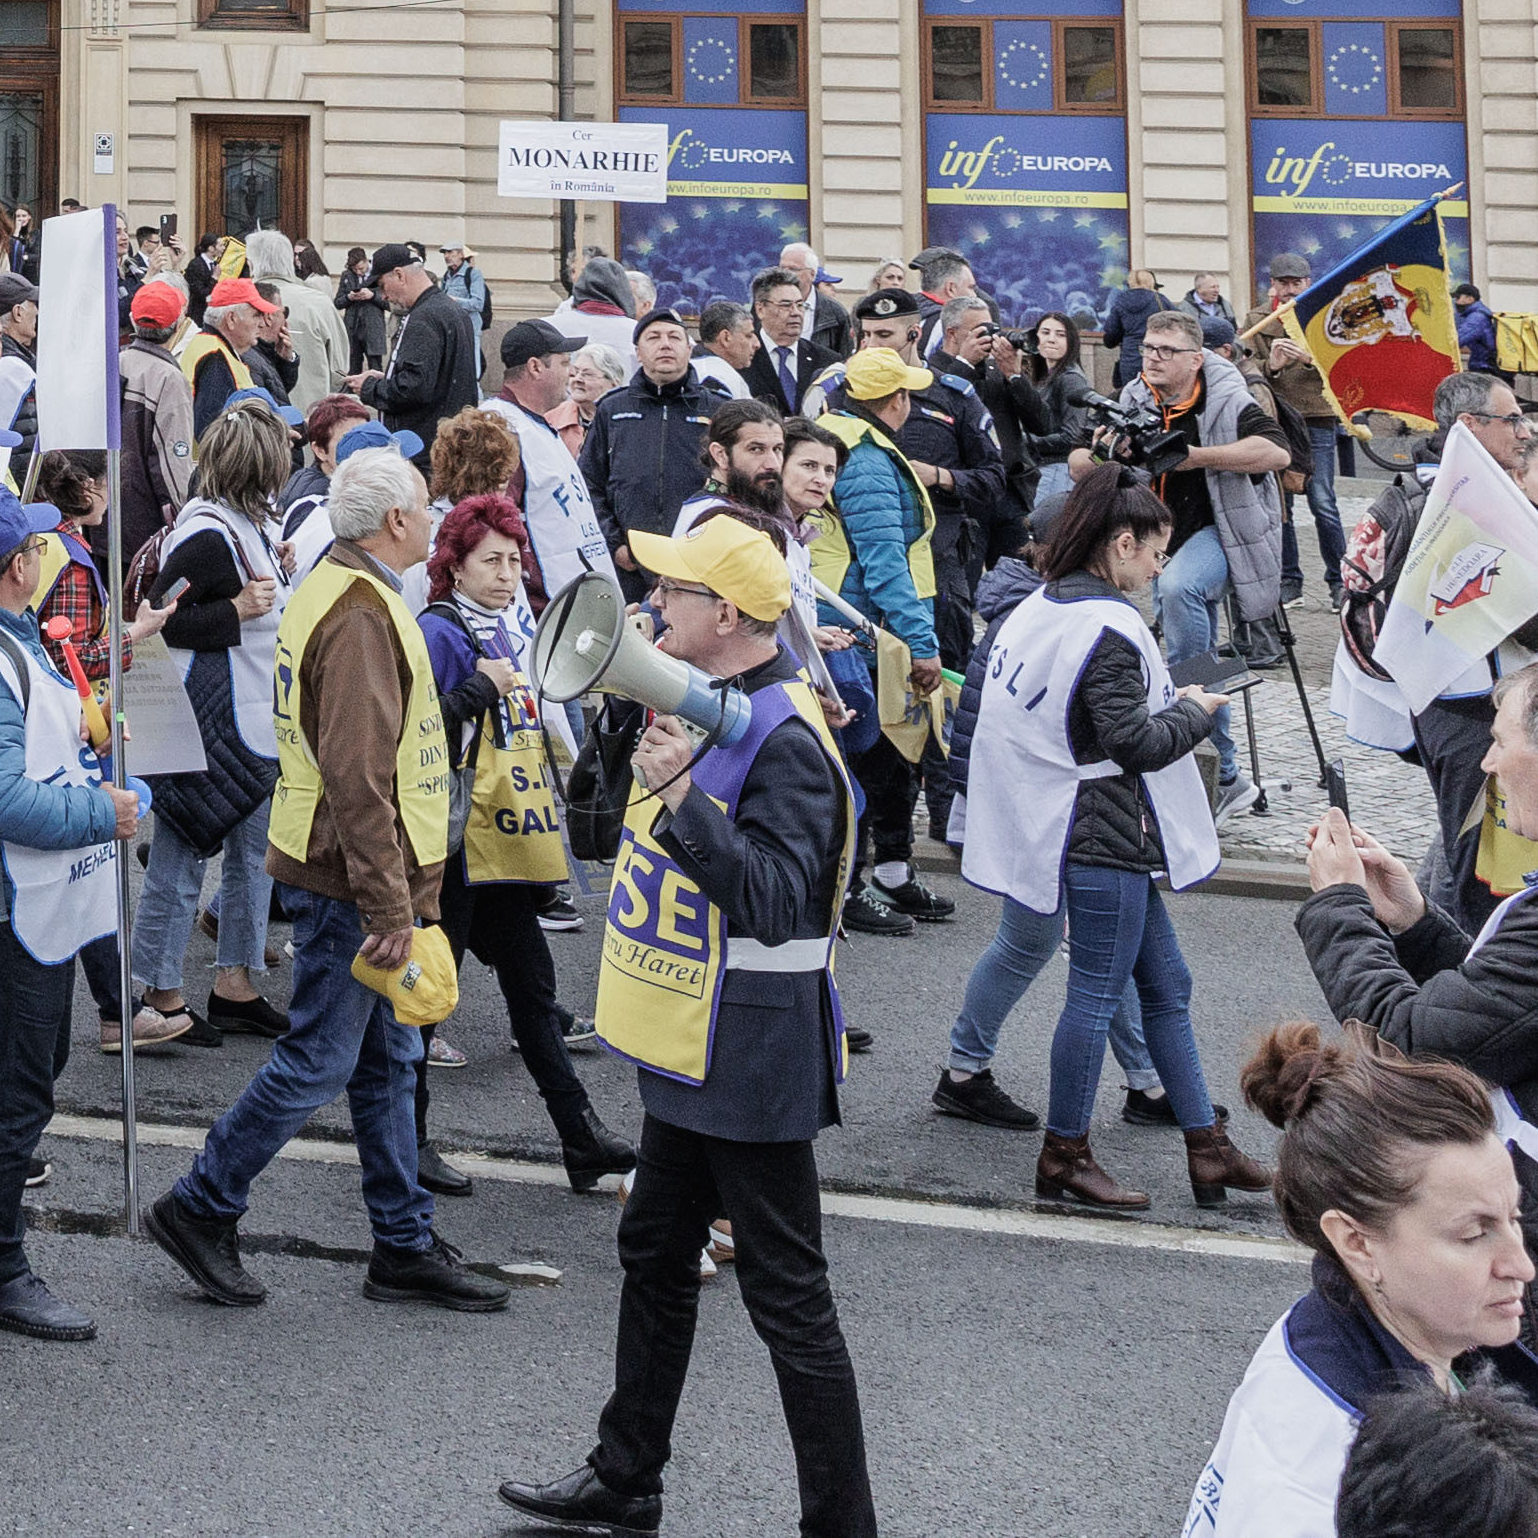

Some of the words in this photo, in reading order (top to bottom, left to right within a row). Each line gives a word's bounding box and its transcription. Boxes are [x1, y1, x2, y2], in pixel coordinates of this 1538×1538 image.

[572, 129, 593, 142] Cer
[508, 146, 660, 174] MONARHIE
[550, 180, 562, 192] în
[564, 180, 616, 194] România
[964, 190, 1089, 206] www.infoeuropa.ro
[625, 943, 702, 986] Haret
